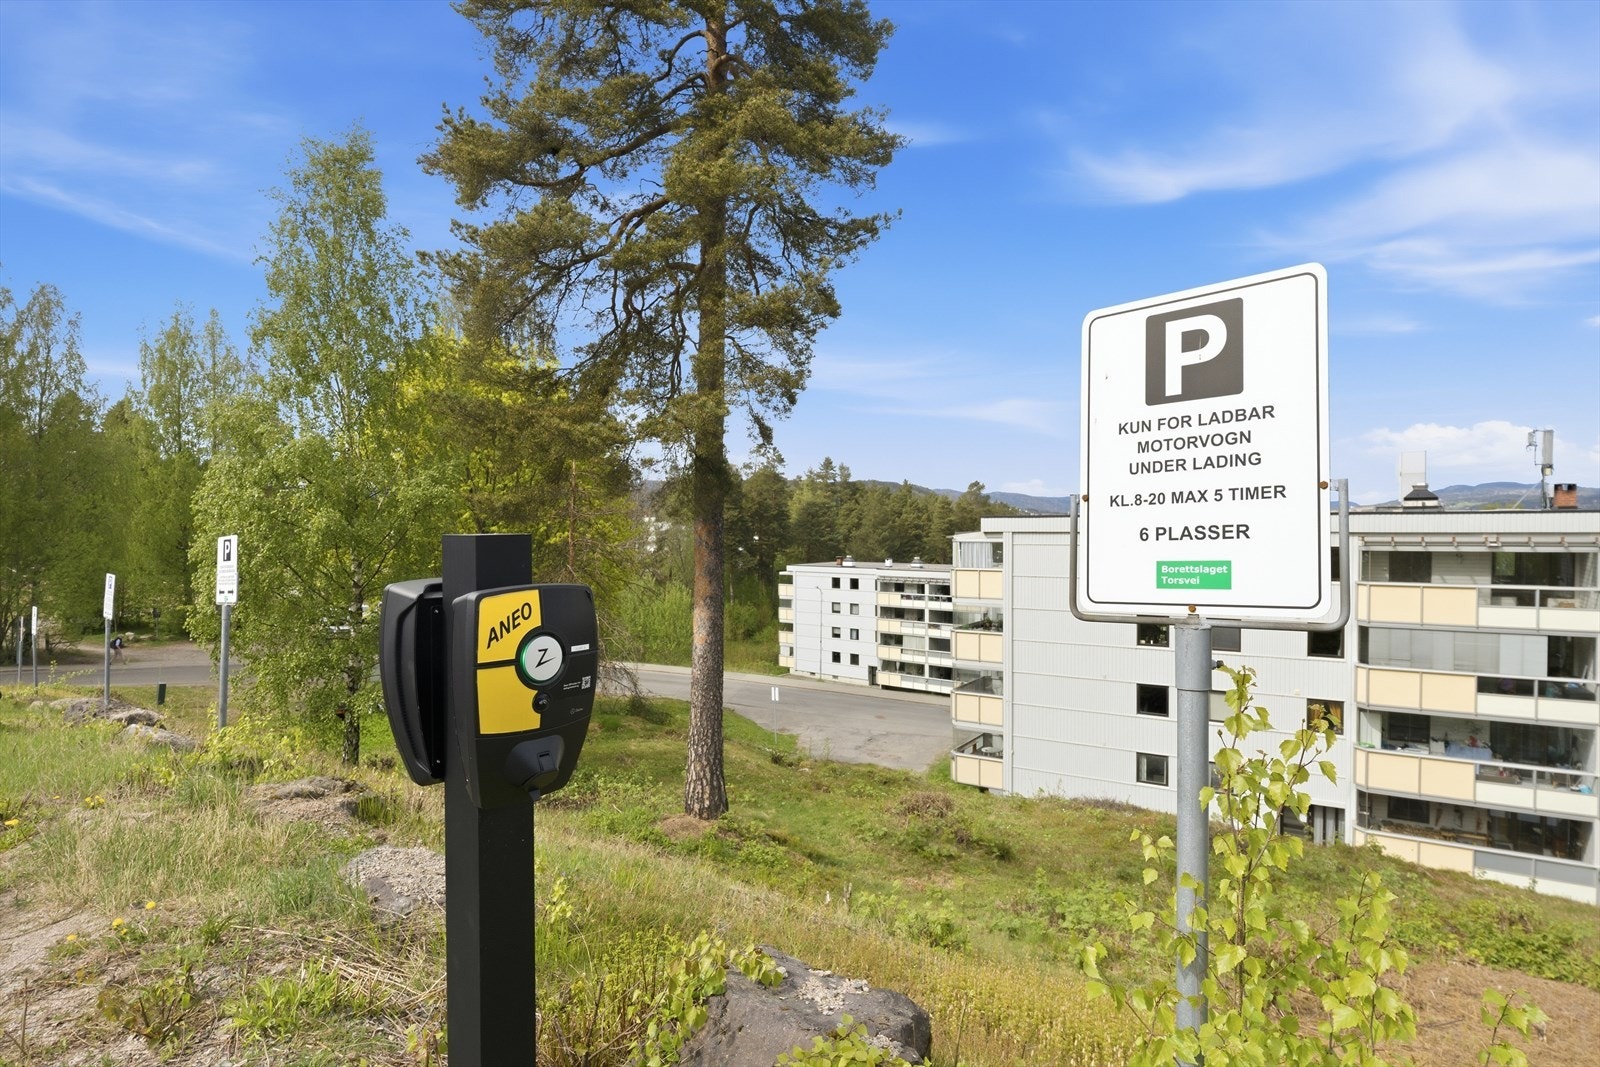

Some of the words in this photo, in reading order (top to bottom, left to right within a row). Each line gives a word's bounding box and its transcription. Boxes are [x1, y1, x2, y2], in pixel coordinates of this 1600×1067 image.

[1165, 314, 1227, 397] P
[1118, 419, 1152, 435] KUN
[1157, 414, 1192, 431] FOR
[1197, 405, 1275, 426] LADBAR
[1137, 430, 1252, 454] MOTORVOGN
[1129, 458, 1187, 475] UNDER
[1192, 452, 1262, 470] LADING
[1109, 492, 1166, 507] KL.8-20
[1171, 489, 1208, 504] MAX
[1213, 488, 1223, 502] 5
[1228, 484, 1287, 501] TIMER
[1139, 526, 1149, 541] 6
[1155, 523, 1251, 541] PLASSER
[1161, 564, 1228, 576] Borettslaget
[1161, 576, 1200, 585] Torsvei
[486, 602, 532, 650] ANEO
